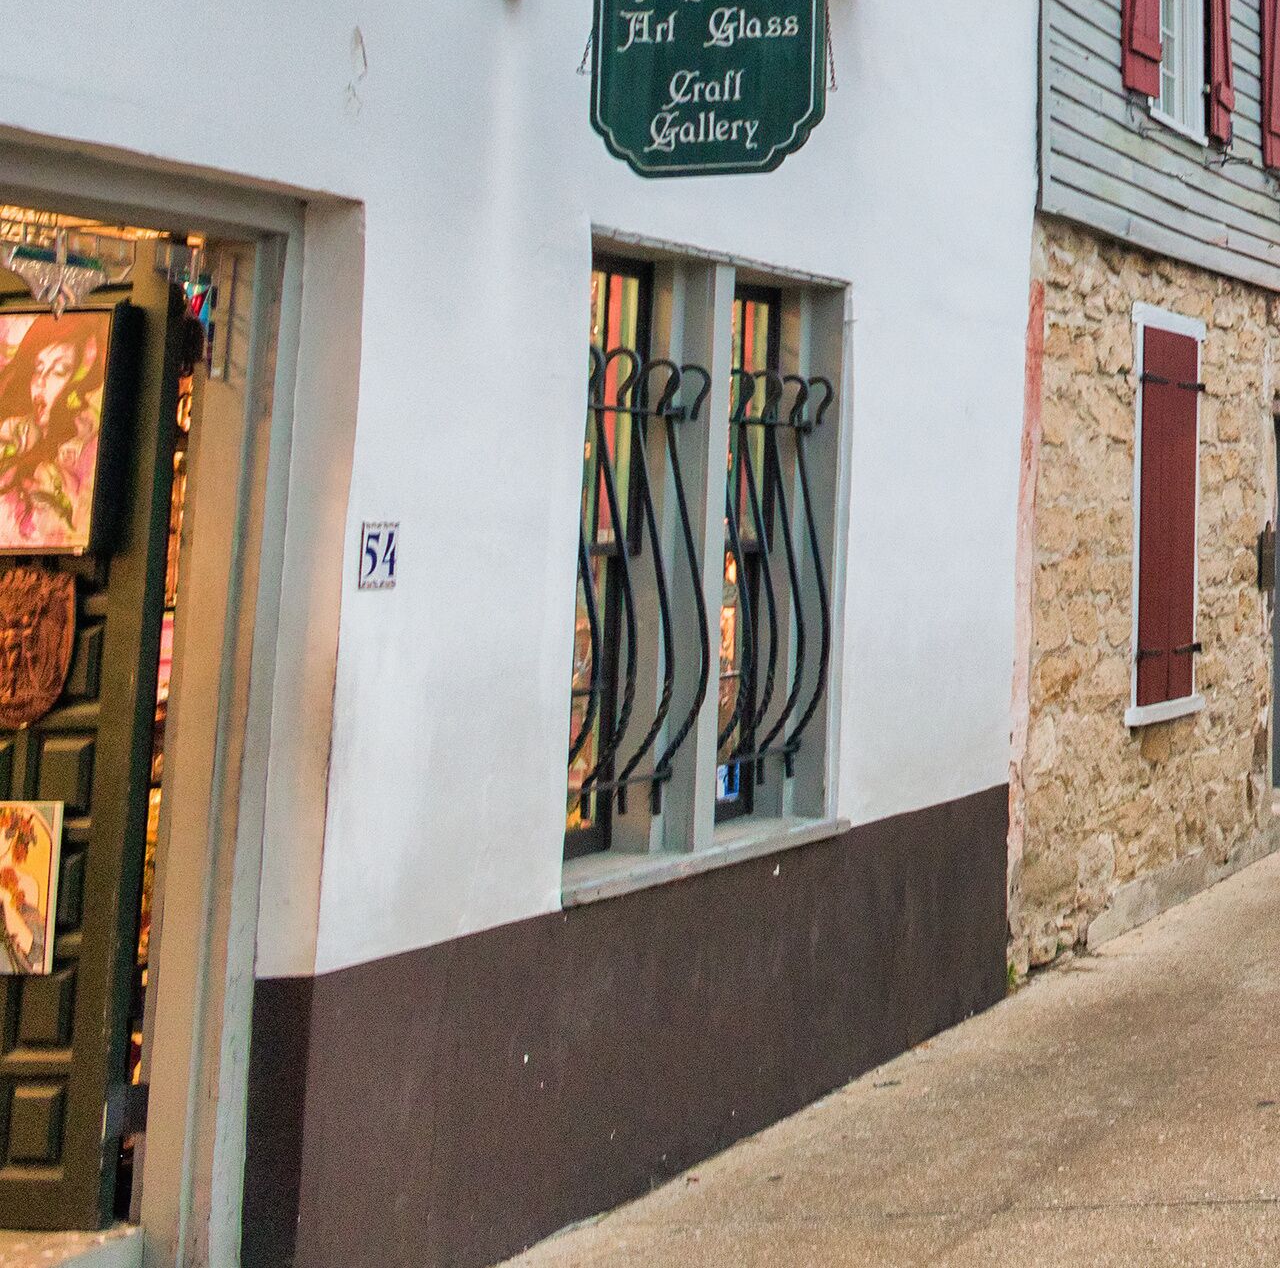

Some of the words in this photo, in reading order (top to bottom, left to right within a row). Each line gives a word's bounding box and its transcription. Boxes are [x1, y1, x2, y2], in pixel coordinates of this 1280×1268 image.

[617, 9, 678, 53] Art
[703, 6, 800, 49] Glass
[662, 68, 746, 111] Craft
[643, 110, 760, 152] Gallery
[364, 530, 397, 578] 54
